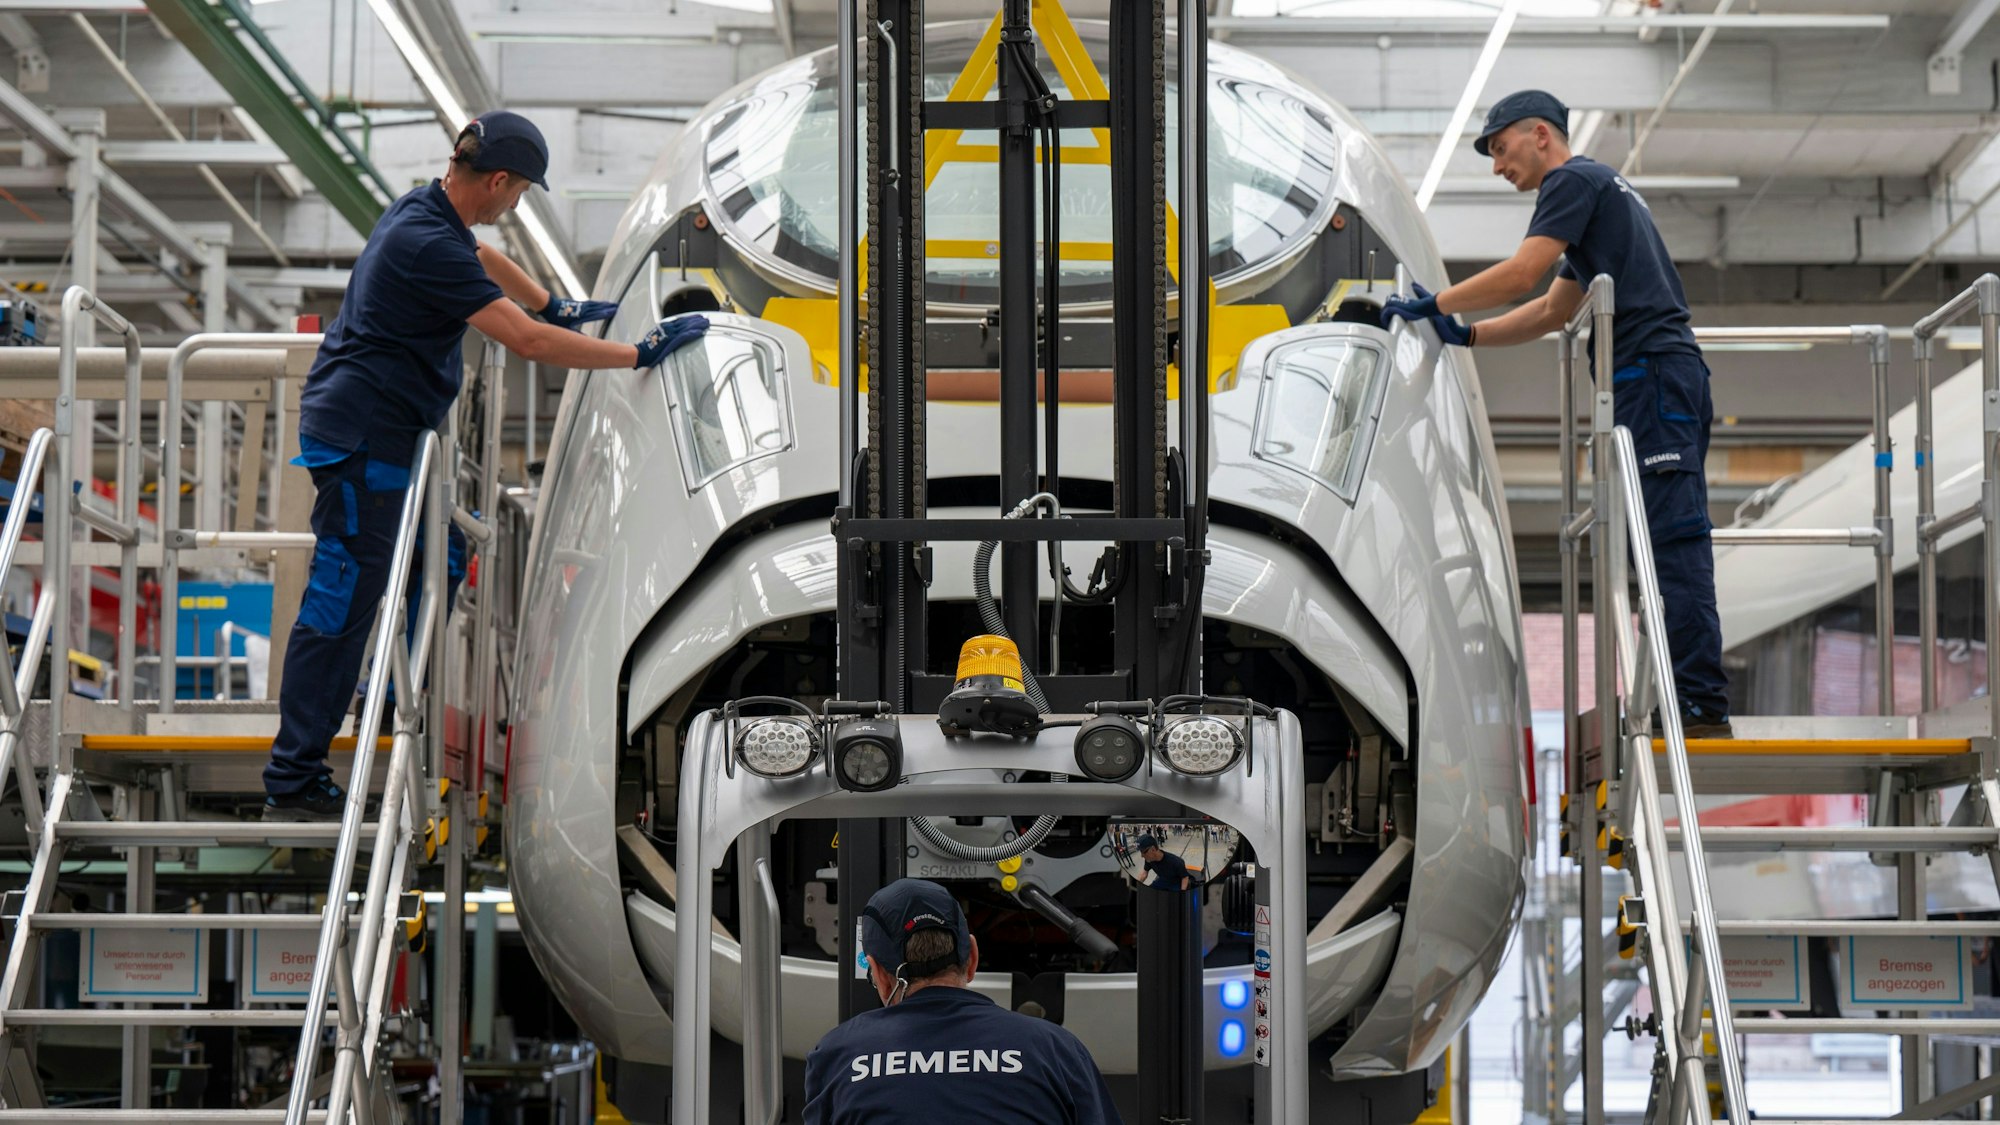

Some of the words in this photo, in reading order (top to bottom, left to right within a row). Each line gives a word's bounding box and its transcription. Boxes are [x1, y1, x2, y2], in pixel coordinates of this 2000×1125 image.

[1643, 452, 1681, 467] SIEMENS
[920, 865, 978, 877] SCHAKU
[103, 950, 143, 960] Umsetzen
[146, 952, 160, 960] nur
[162, 950, 186, 960] durch
[281, 951, 317, 965] Brem
[1745, 959, 1758, 967] nur
[1761, 958, 1785, 967] durch
[1879, 959, 1933, 973] Bremse
[125, 971, 162, 981] Personal
[269, 971, 313, 985] angez
[1868, 978, 1945, 993] angezogen
[850, 1049, 1023, 1082] SIEMENS
